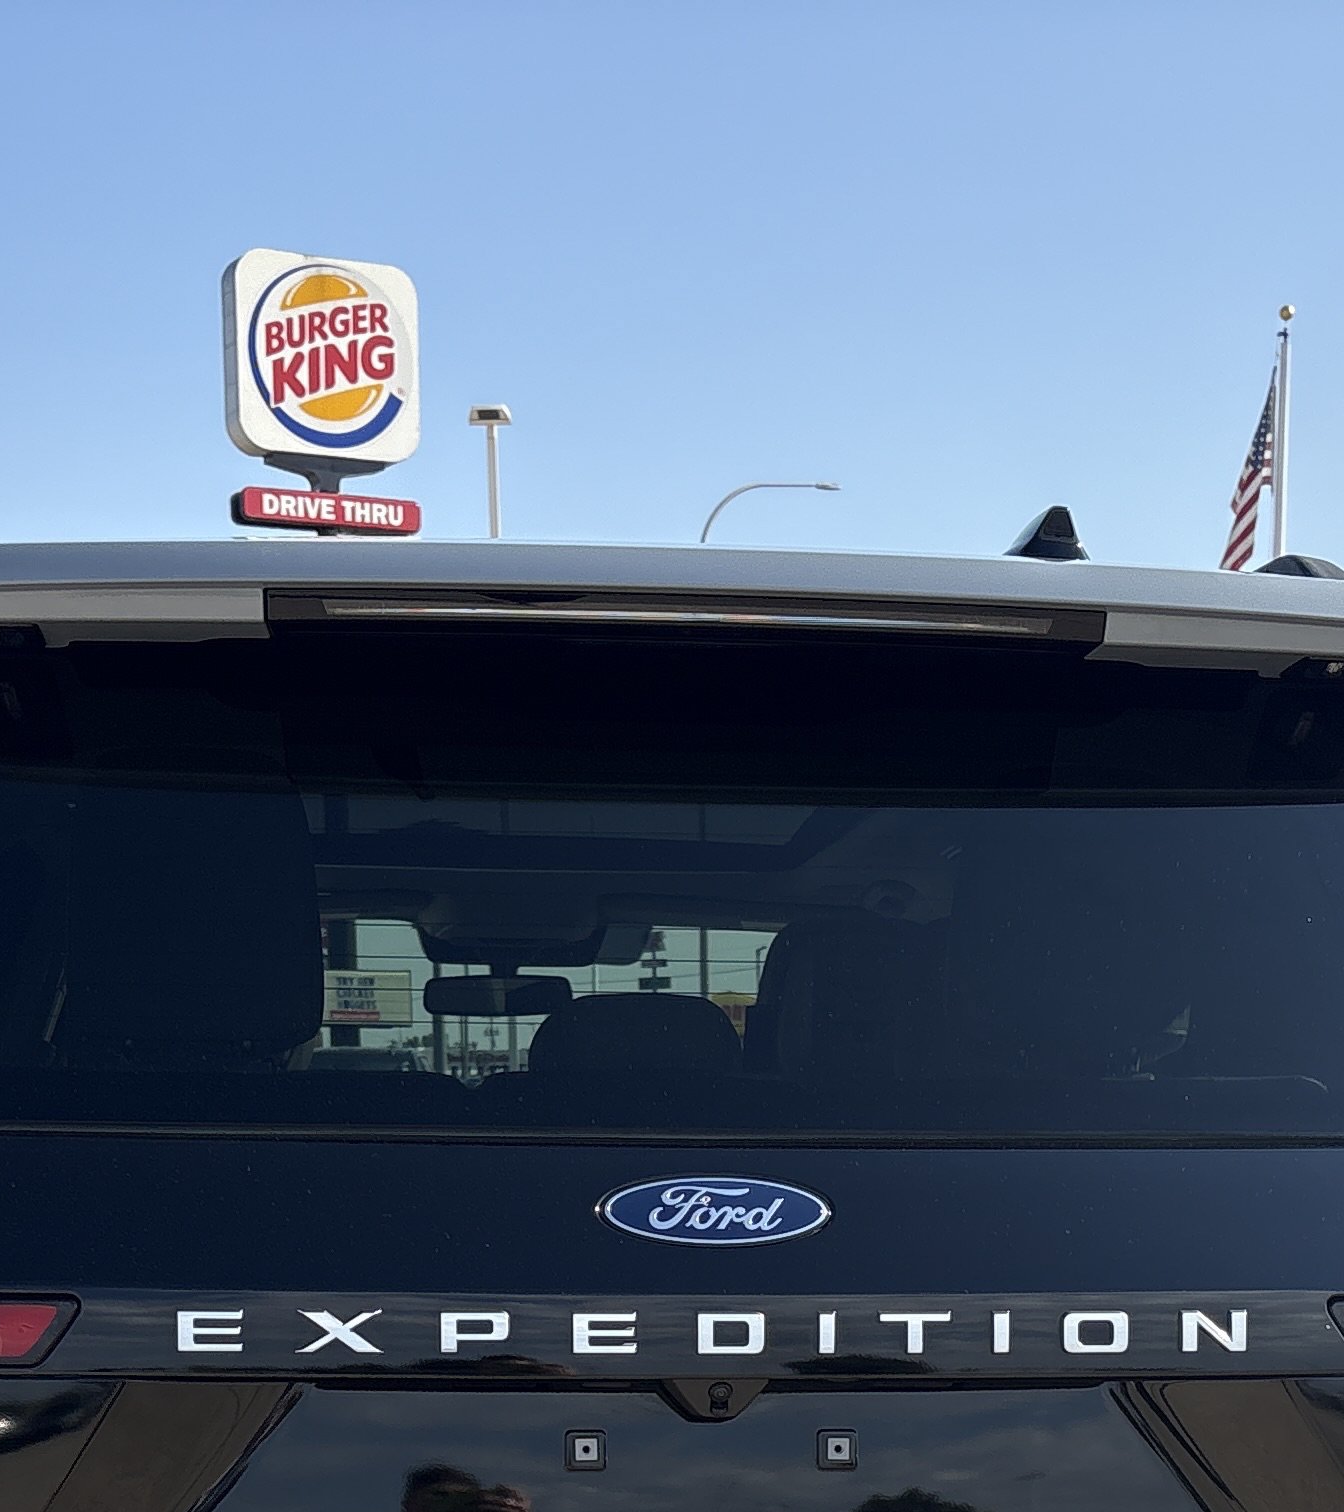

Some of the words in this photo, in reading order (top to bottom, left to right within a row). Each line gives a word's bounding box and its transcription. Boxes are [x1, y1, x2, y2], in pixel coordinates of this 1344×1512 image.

[265, 303, 390, 357] BURGER
[272, 335, 396, 405] KING
[261, 494, 336, 521] DRIVE
[341, 501, 404, 526] THRU
[648, 1185, 785, 1231] Ford
[176, 1308, 1249, 1354] EXPEDITION
